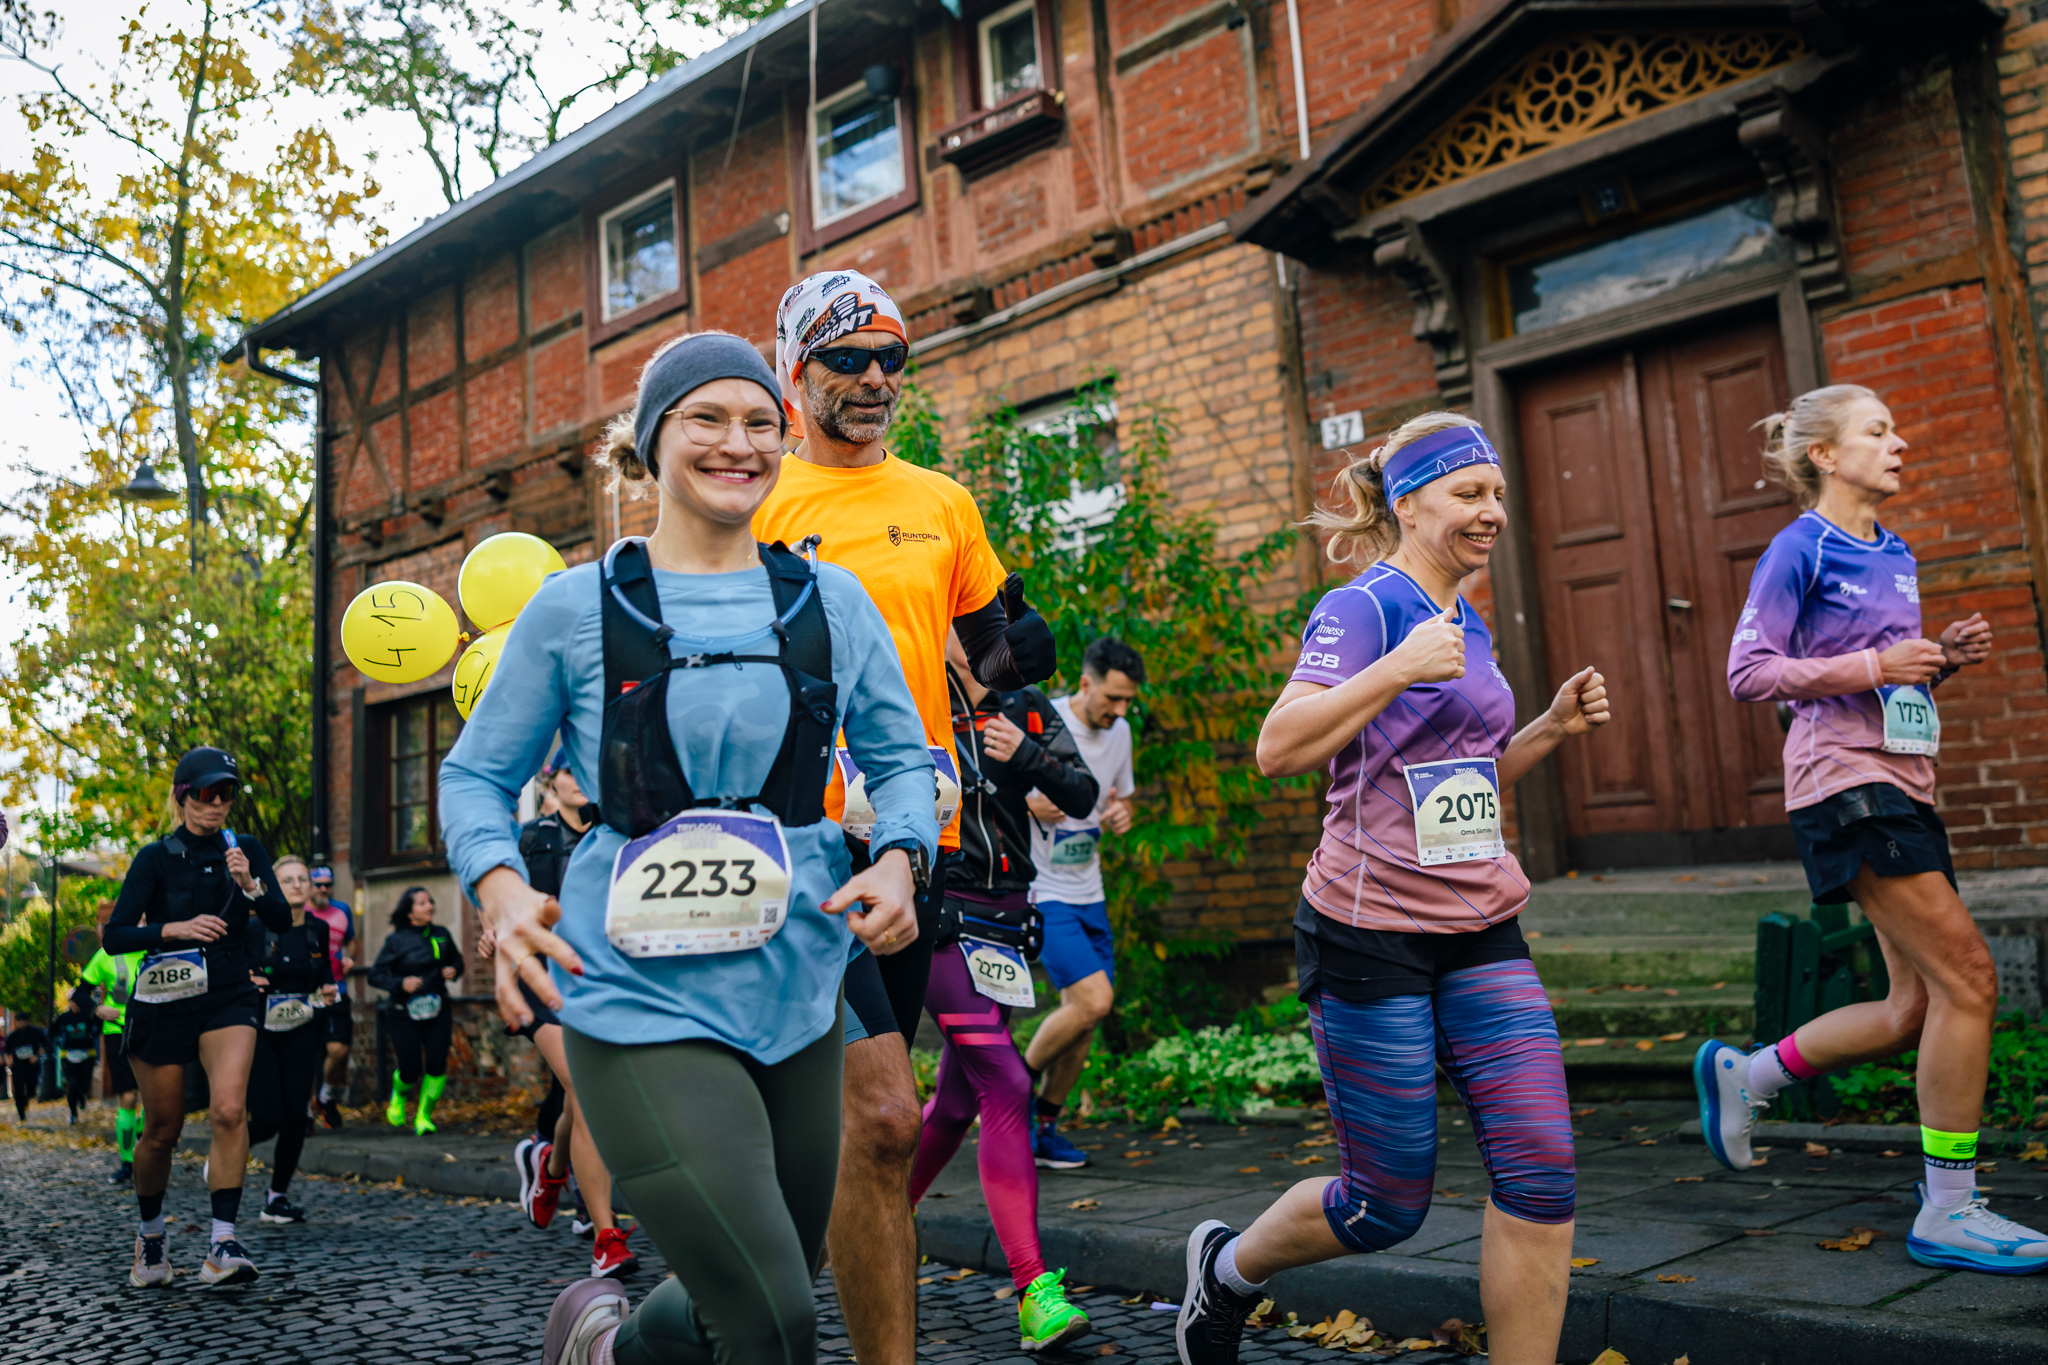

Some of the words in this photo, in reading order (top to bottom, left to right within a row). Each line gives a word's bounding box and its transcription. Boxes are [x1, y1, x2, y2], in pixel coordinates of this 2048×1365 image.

[805, 309, 832, 342] ULTRA
[1329, 417, 1353, 445] 37
[1435, 792, 1496, 824] 2075
[641, 859, 757, 901] 2233
[689, 910, 711, 918] Ewa
[148, 967, 191, 985] 2188
[975, 957, 1016, 981] 2279
